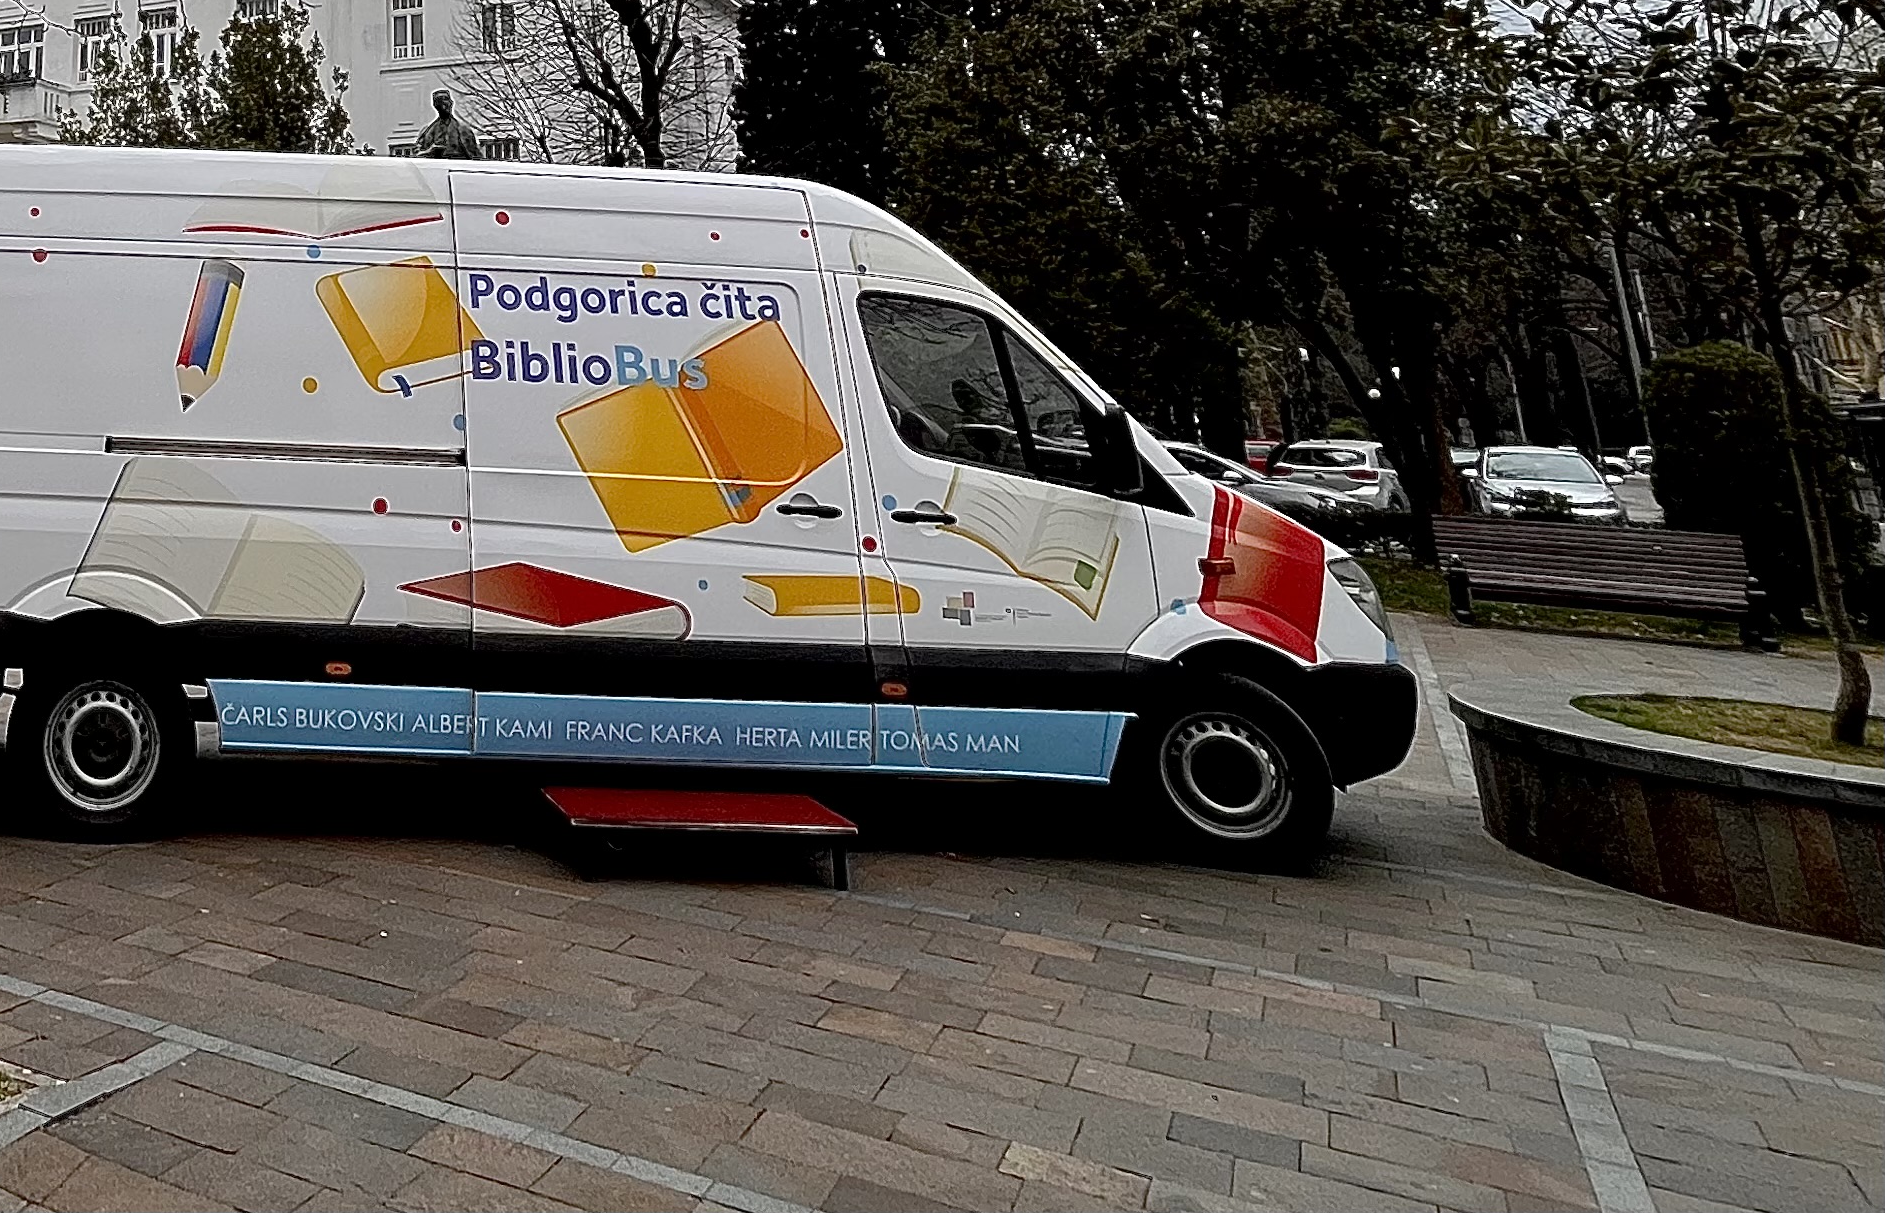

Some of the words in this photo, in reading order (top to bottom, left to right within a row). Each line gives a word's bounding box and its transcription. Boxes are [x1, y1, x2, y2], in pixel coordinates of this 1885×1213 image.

[469, 274, 688, 323] Podgorica
[700, 282, 781, 321] čita
[471, 339, 708, 389] BiblioBus
[221, 703, 287, 728] ČARLS
[296, 709, 403, 733] BUKOVSKI
[496, 718, 552, 740] KAMI
[566, 720, 644, 744] FRANC
[651, 724, 722, 747] KAFKA
[736, 727, 802, 749] HERTA
[810, 729, 872, 751] MILER
[880, 730, 959, 753] TOMAS
[966, 733, 1020, 754] MAN
